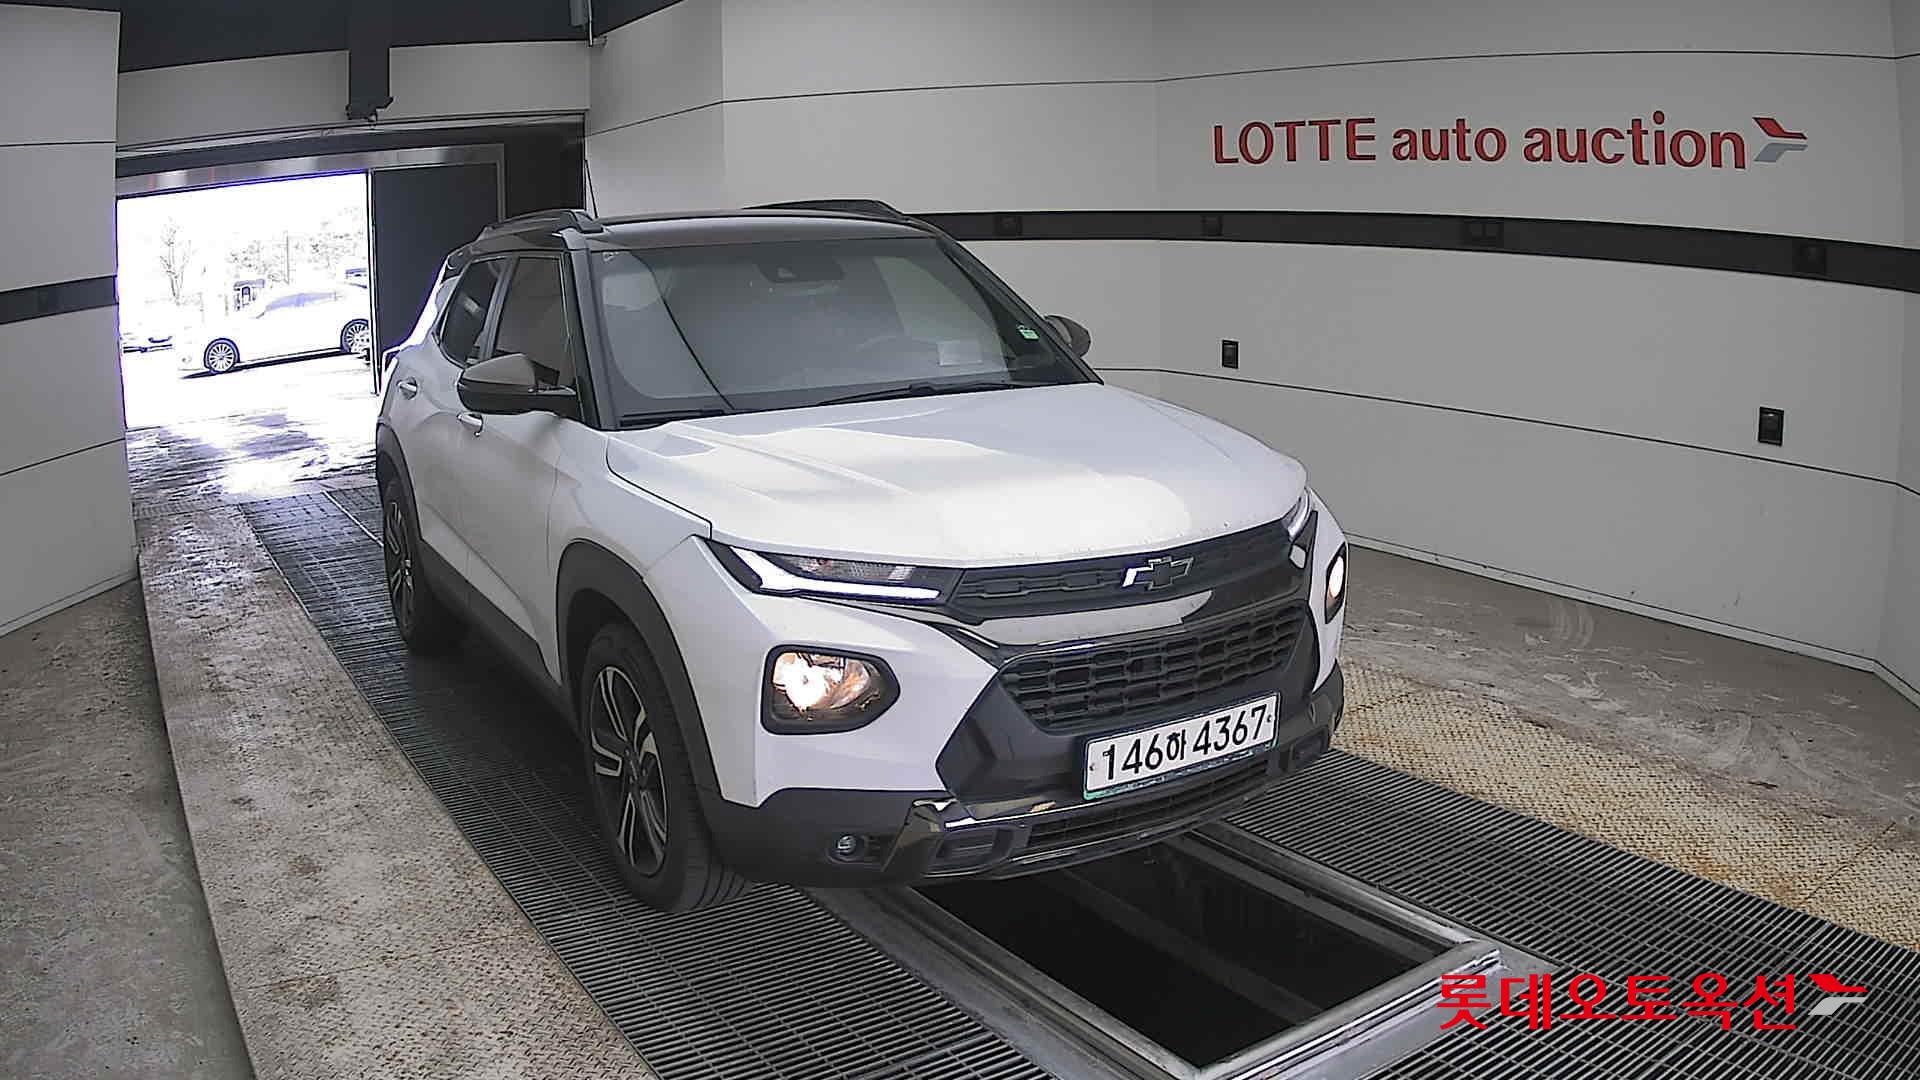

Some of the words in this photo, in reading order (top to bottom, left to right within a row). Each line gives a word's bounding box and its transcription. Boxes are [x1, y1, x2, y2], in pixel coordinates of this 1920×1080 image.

[1213, 118, 1377, 164] LOTTE
[1392, 117, 1507, 162] auto
[1523, 110, 1746, 169] auction
[1192, 704, 1267, 755] 4367
